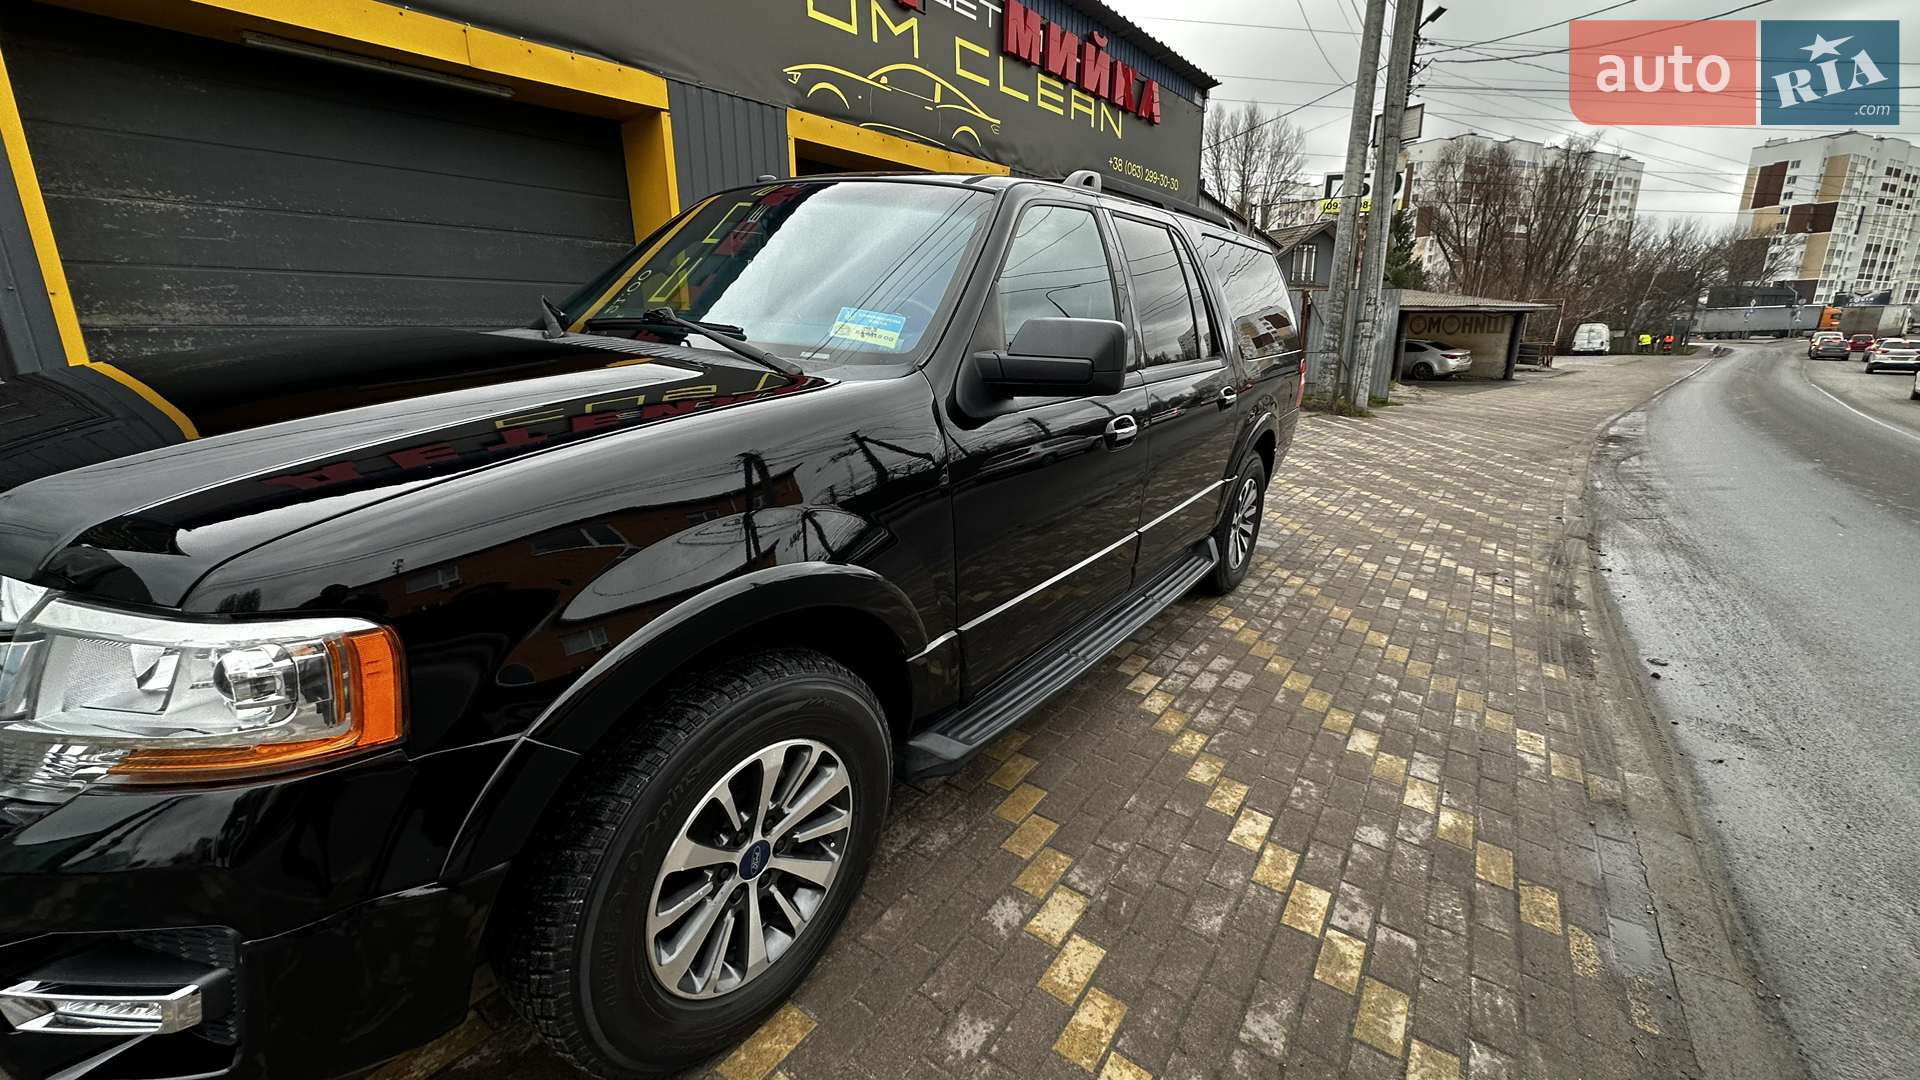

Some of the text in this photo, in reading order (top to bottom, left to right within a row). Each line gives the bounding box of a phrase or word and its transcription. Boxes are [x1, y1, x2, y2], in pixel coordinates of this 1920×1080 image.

[955, 36, 1122, 139] CLEAN
[1004, 0, 1161, 125] МИЙКА
[1108, 156, 1179, 191] +38 (063) 299-30-30
